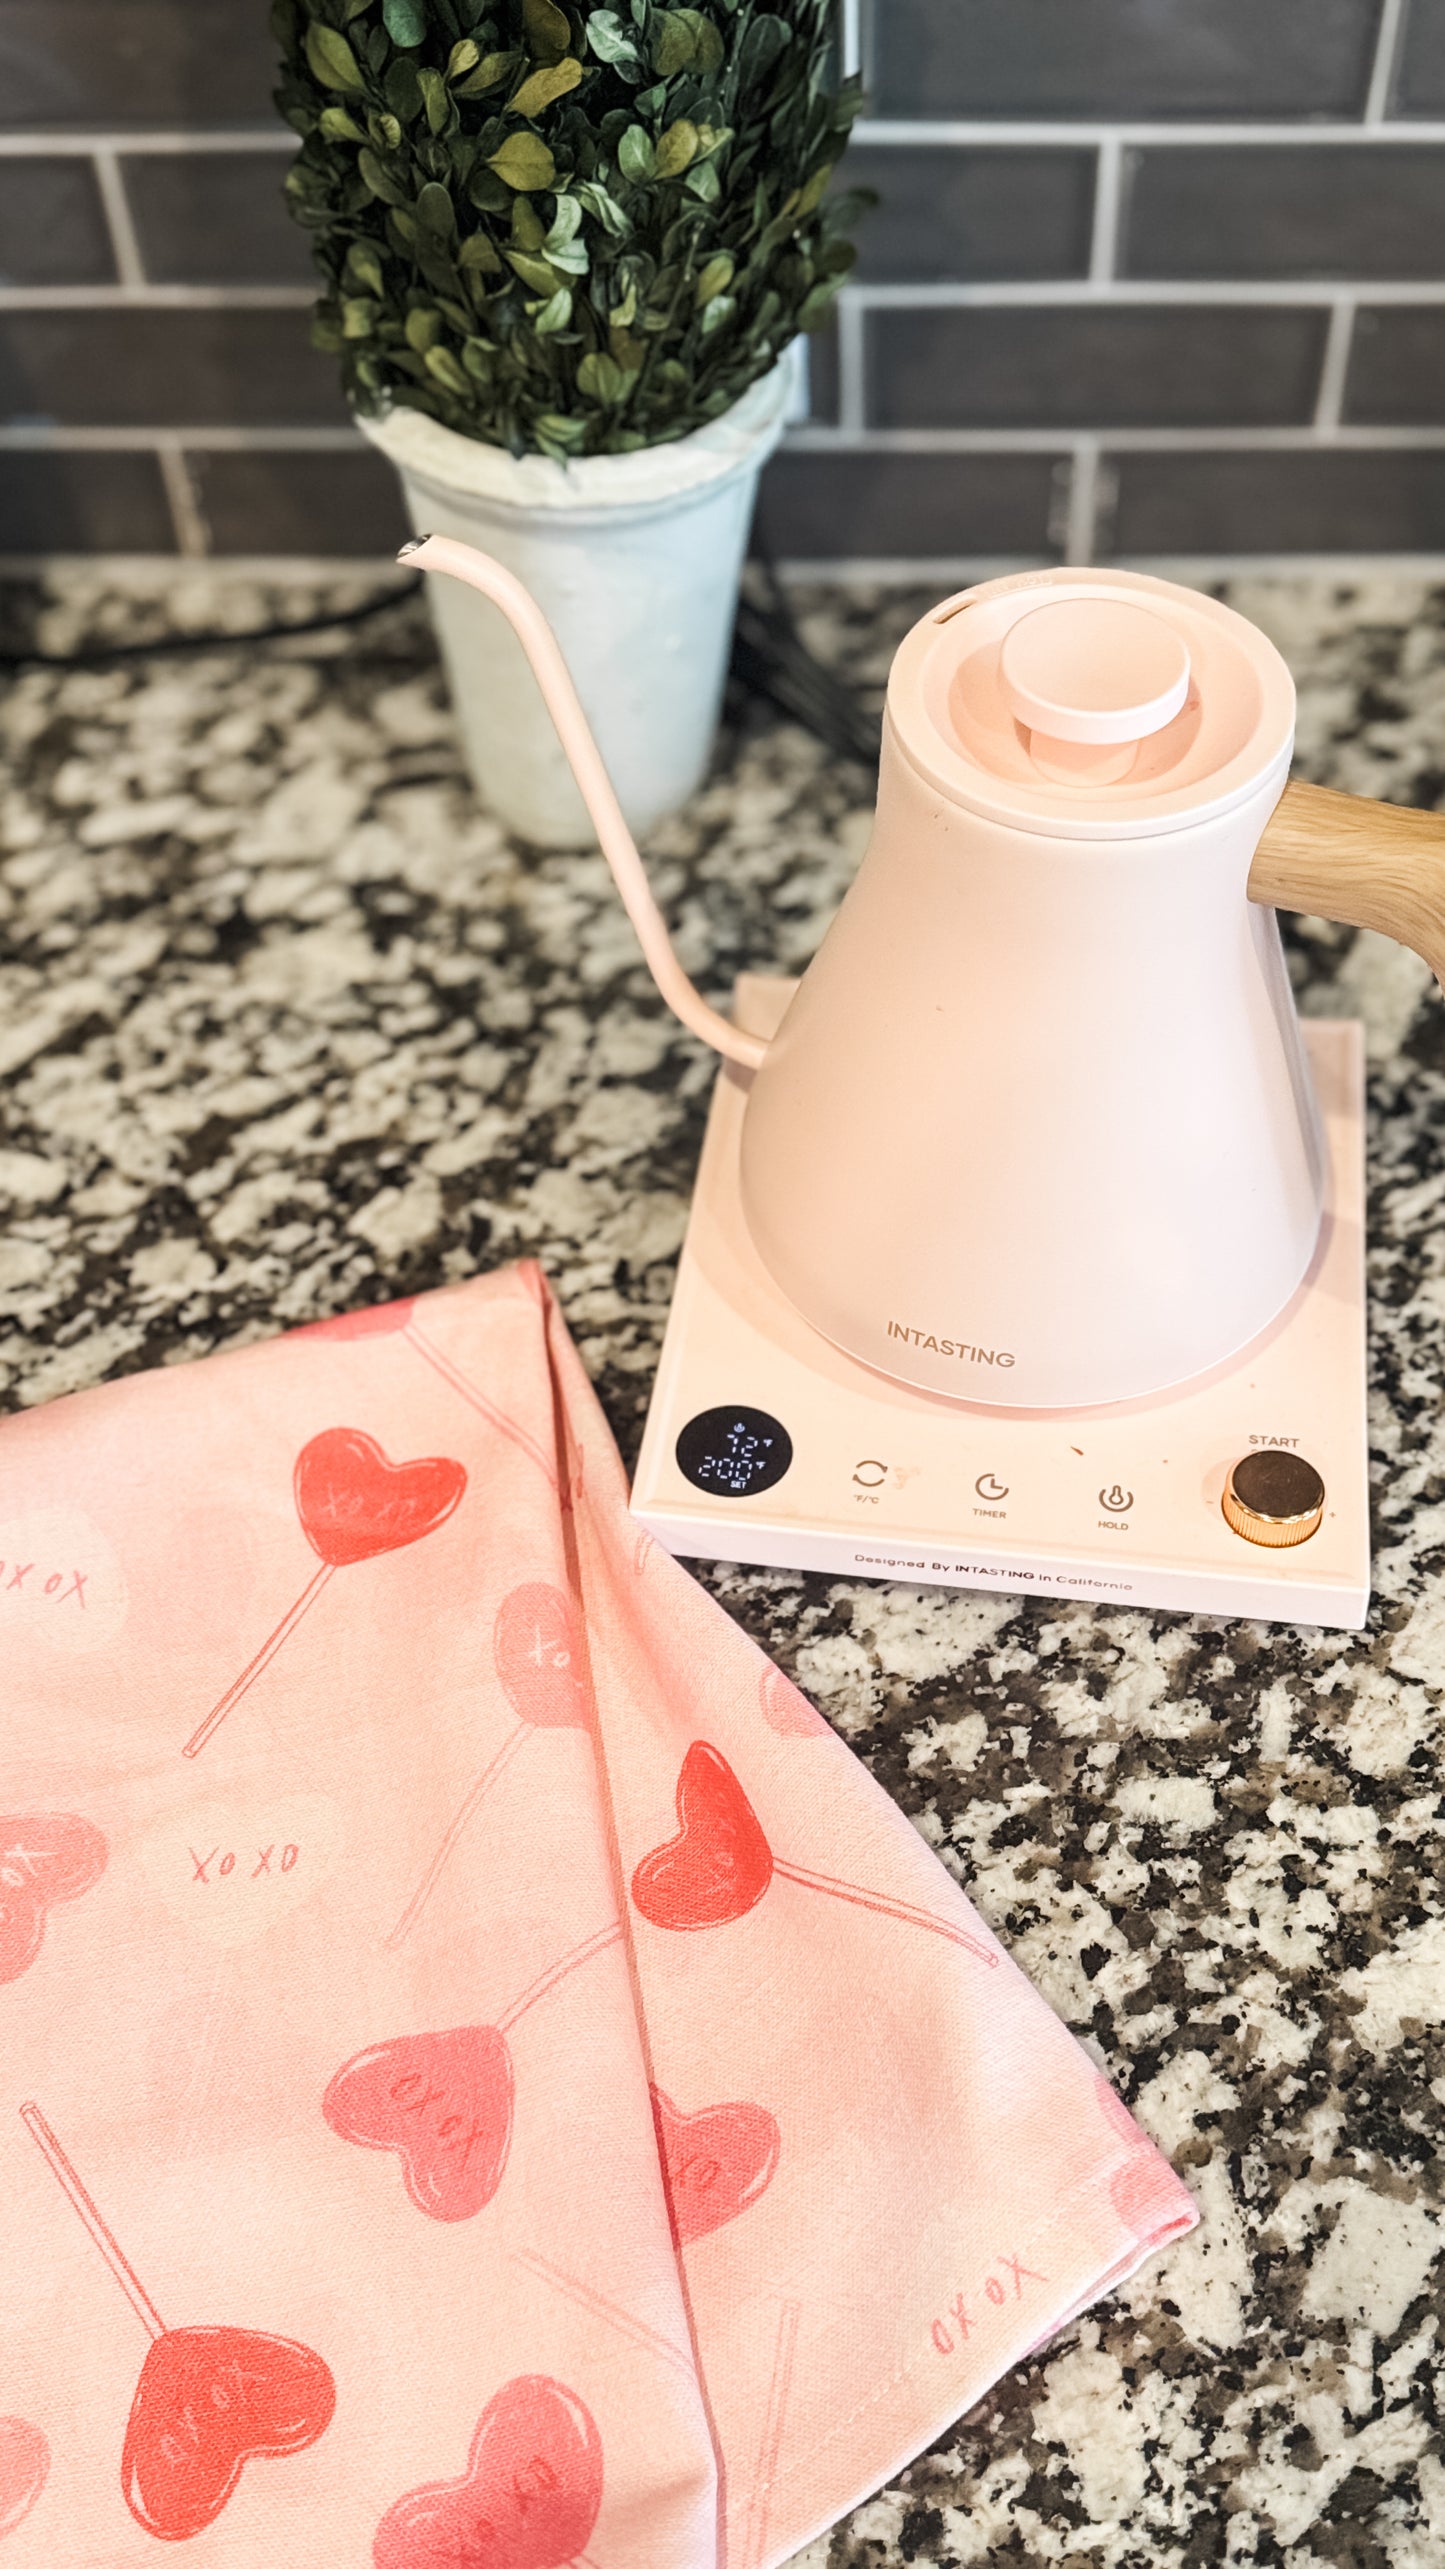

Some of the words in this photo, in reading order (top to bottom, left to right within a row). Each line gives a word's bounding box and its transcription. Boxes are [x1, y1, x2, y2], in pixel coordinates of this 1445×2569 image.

[887, 1320, 1016, 1368] INTASTING
[1248, 1434, 1301, 1448] START
[730, 1480, 747, 1489] SET
[972, 1508, 1008, 1519] TIMER
[1098, 1520, 1130, 1531] HOLD
[854, 1554, 926, 1569] Designed
[931, 1562, 951, 1572] By
[955, 1565, 1035, 1580] INTASTING
[1056, 1576, 1133, 1591] California
